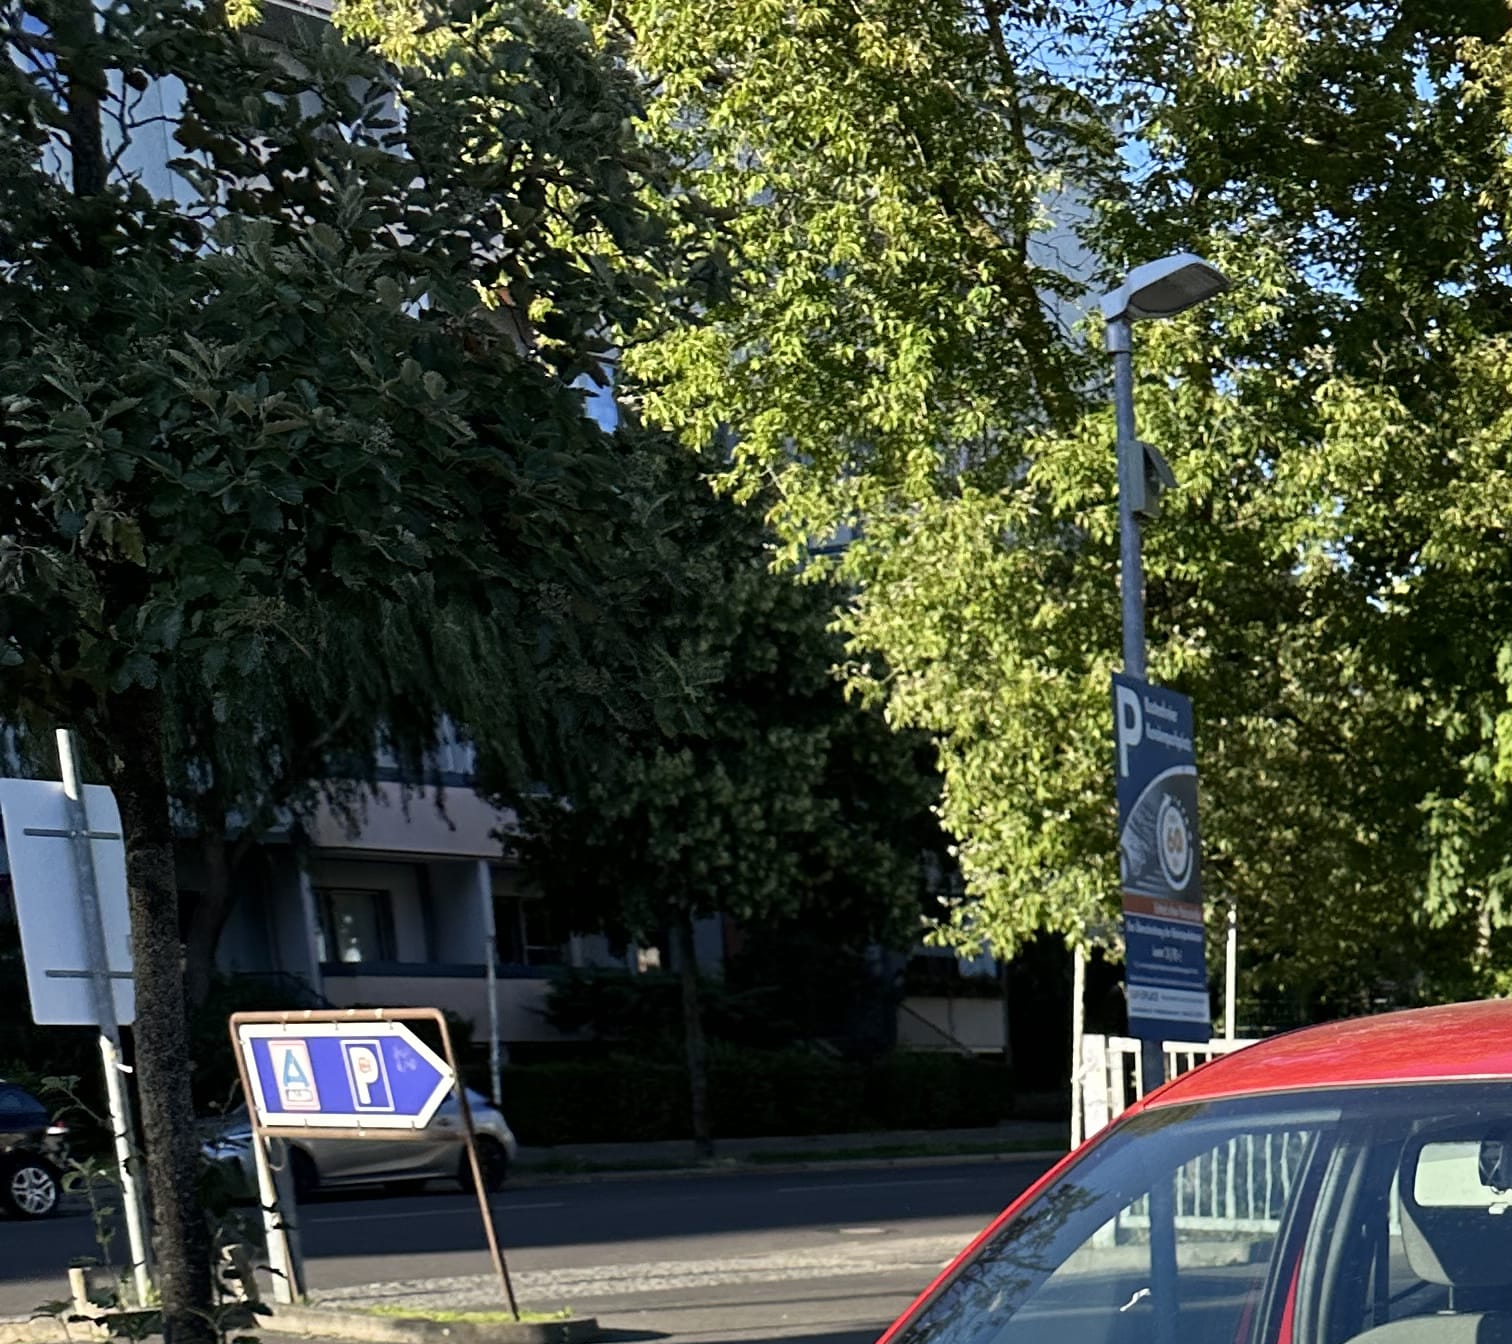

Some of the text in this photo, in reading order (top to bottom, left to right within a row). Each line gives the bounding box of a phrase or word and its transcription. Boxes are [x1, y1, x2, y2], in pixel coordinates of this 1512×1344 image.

[1116, 684, 1143, 777] P
[283, 1049, 310, 1087] A
[349, 1047, 379, 1104] P
